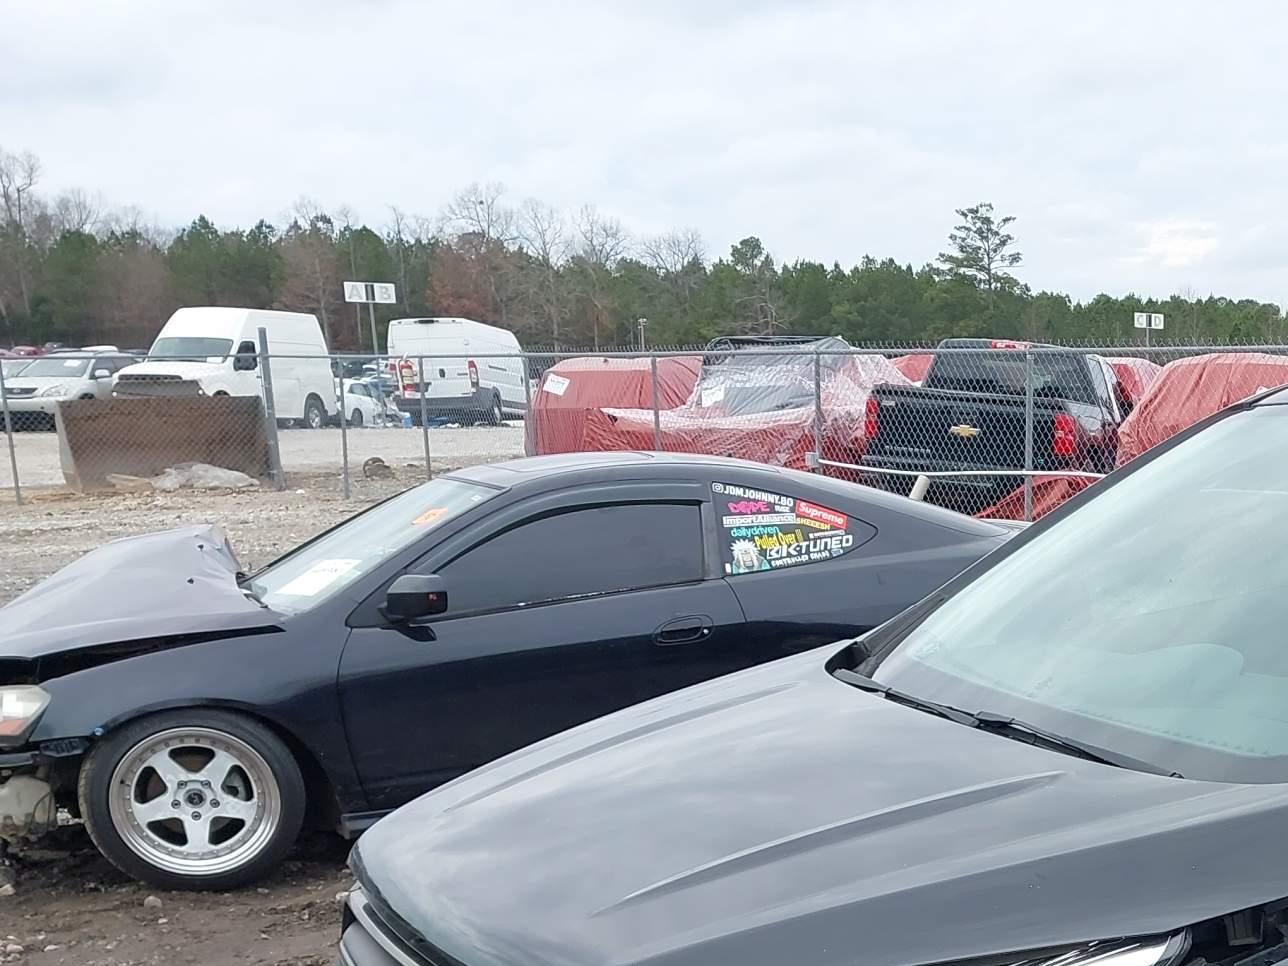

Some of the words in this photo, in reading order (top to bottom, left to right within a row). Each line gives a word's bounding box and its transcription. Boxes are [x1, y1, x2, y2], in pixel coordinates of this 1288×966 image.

[347, 284, 363, 299] A
[379, 285, 391, 299] B
[1136, 314, 1144, 327] C
[1153, 315, 1161, 327] D
[798, 502, 845, 525] Supreme
